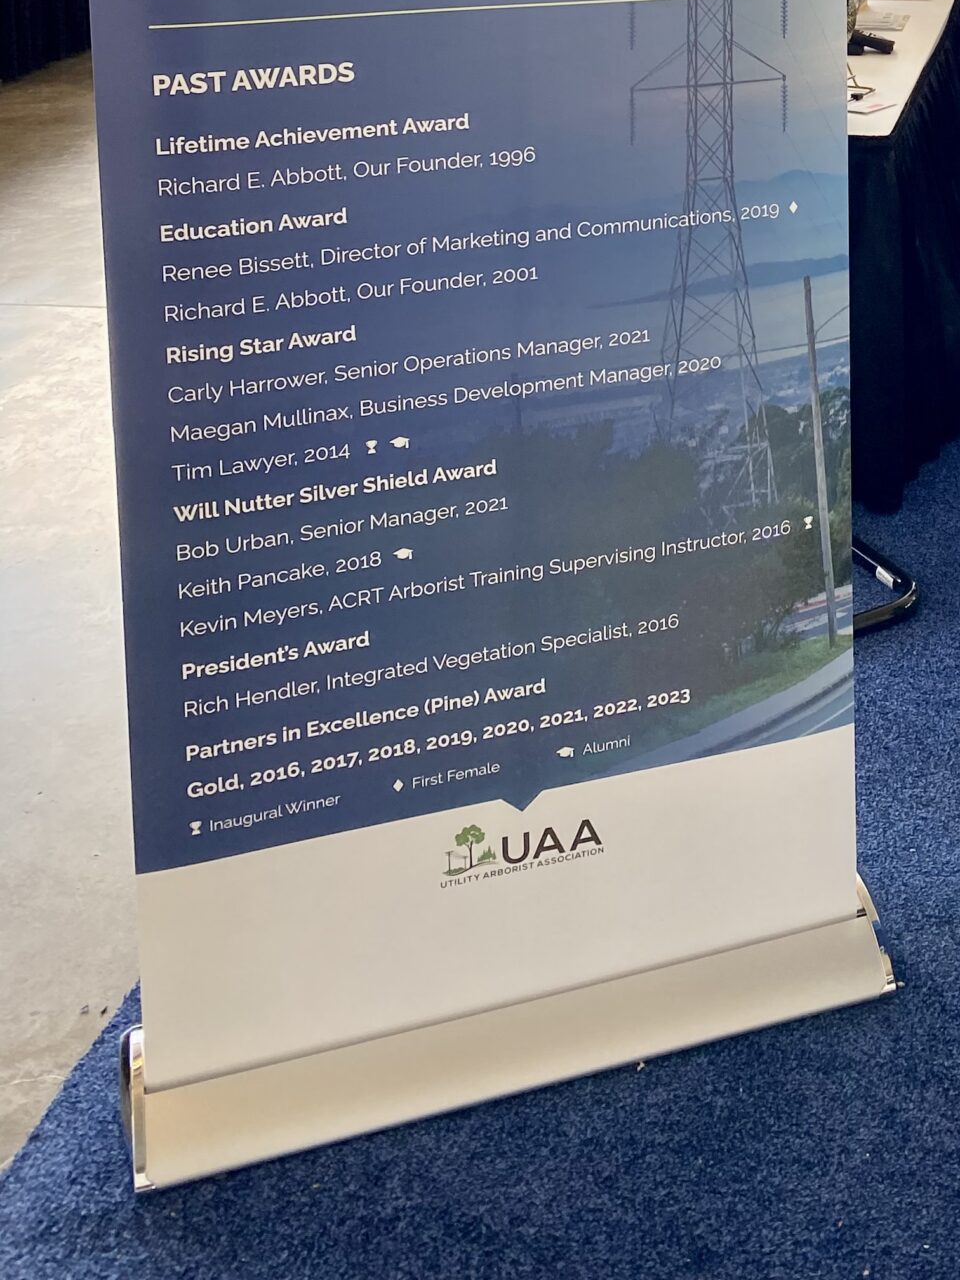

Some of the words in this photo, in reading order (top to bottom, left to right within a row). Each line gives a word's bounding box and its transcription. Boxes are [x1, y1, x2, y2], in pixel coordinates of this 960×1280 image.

[152, 71, 226, 96] PAST
[232, 62, 355, 92] AWARDS
[155, 136, 250, 155] Lifetime
[255, 121, 398, 148] Achievement
[402, 113, 469, 133] Award
[158, 173, 240, 196] Richard
[247, 172, 265, 189] E.
[271, 164, 347, 187] Abbott,
[353, 160, 391, 178] Our
[397, 152, 484, 174] Founder,
[489, 146, 536, 168] 1996
[160, 217, 273, 242] Education
[278, 207, 348, 231] Award
[162, 261, 232, 282] Renee
[239, 252, 314, 276] Bissett,
[321, 243, 402, 266] Director
[406, 237, 427, 255] of
[432, 228, 530, 253] Marketing
[536, 223, 571, 242] and
[577, 208, 735, 237] Communications,
[740, 203, 780, 220] 2019
[166, 342, 234, 364] Rising
[240, 337, 284, 356] Star
[288, 325, 356, 349] Award
[172, 464, 212, 482] Tim
[219, 455, 297, 476] Lawyer,
[304, 444, 351, 462] 2014
[173, 502, 220, 522] Will
[225, 494, 295, 516] Nutter
[299, 484, 358, 505] Silver
[363, 469, 429, 493] Shield
[433, 459, 497, 483] Award
[181, 646, 299, 680] President's
[303, 631, 370, 657] Award
[185, 733, 278, 762] Partners
[283, 726, 301, 743] in
[306, 703, 419, 737] Excellence
[424, 691, 480, 715] (Pine)
[483, 678, 546, 704] Award
[187, 774, 245, 798] Gold,
[250, 763, 306, 786] 2016,
[311, 752, 363, 774] 2017,
[368, 739, 421, 762] 2018,
[426, 729, 477, 751] 2019,
[482, 718, 534, 739] 2020,
[539, 707, 588, 729] 2021,
[593, 698, 642, 720] 2022,
[647, 688, 691, 709] 2023
[209, 806, 283, 833] Inaugural
[286, 794, 341, 817] Winner
[411, 774, 444, 790] First
[447, 761, 501, 782] Female
[582, 735, 631, 756] Alumni
[501, 819, 602, 865] UAA
[440, 873, 481, 889] UTILITY
[482, 862, 535, 881] ARBORIST
[537, 846, 605, 868] ASSOCIATION
